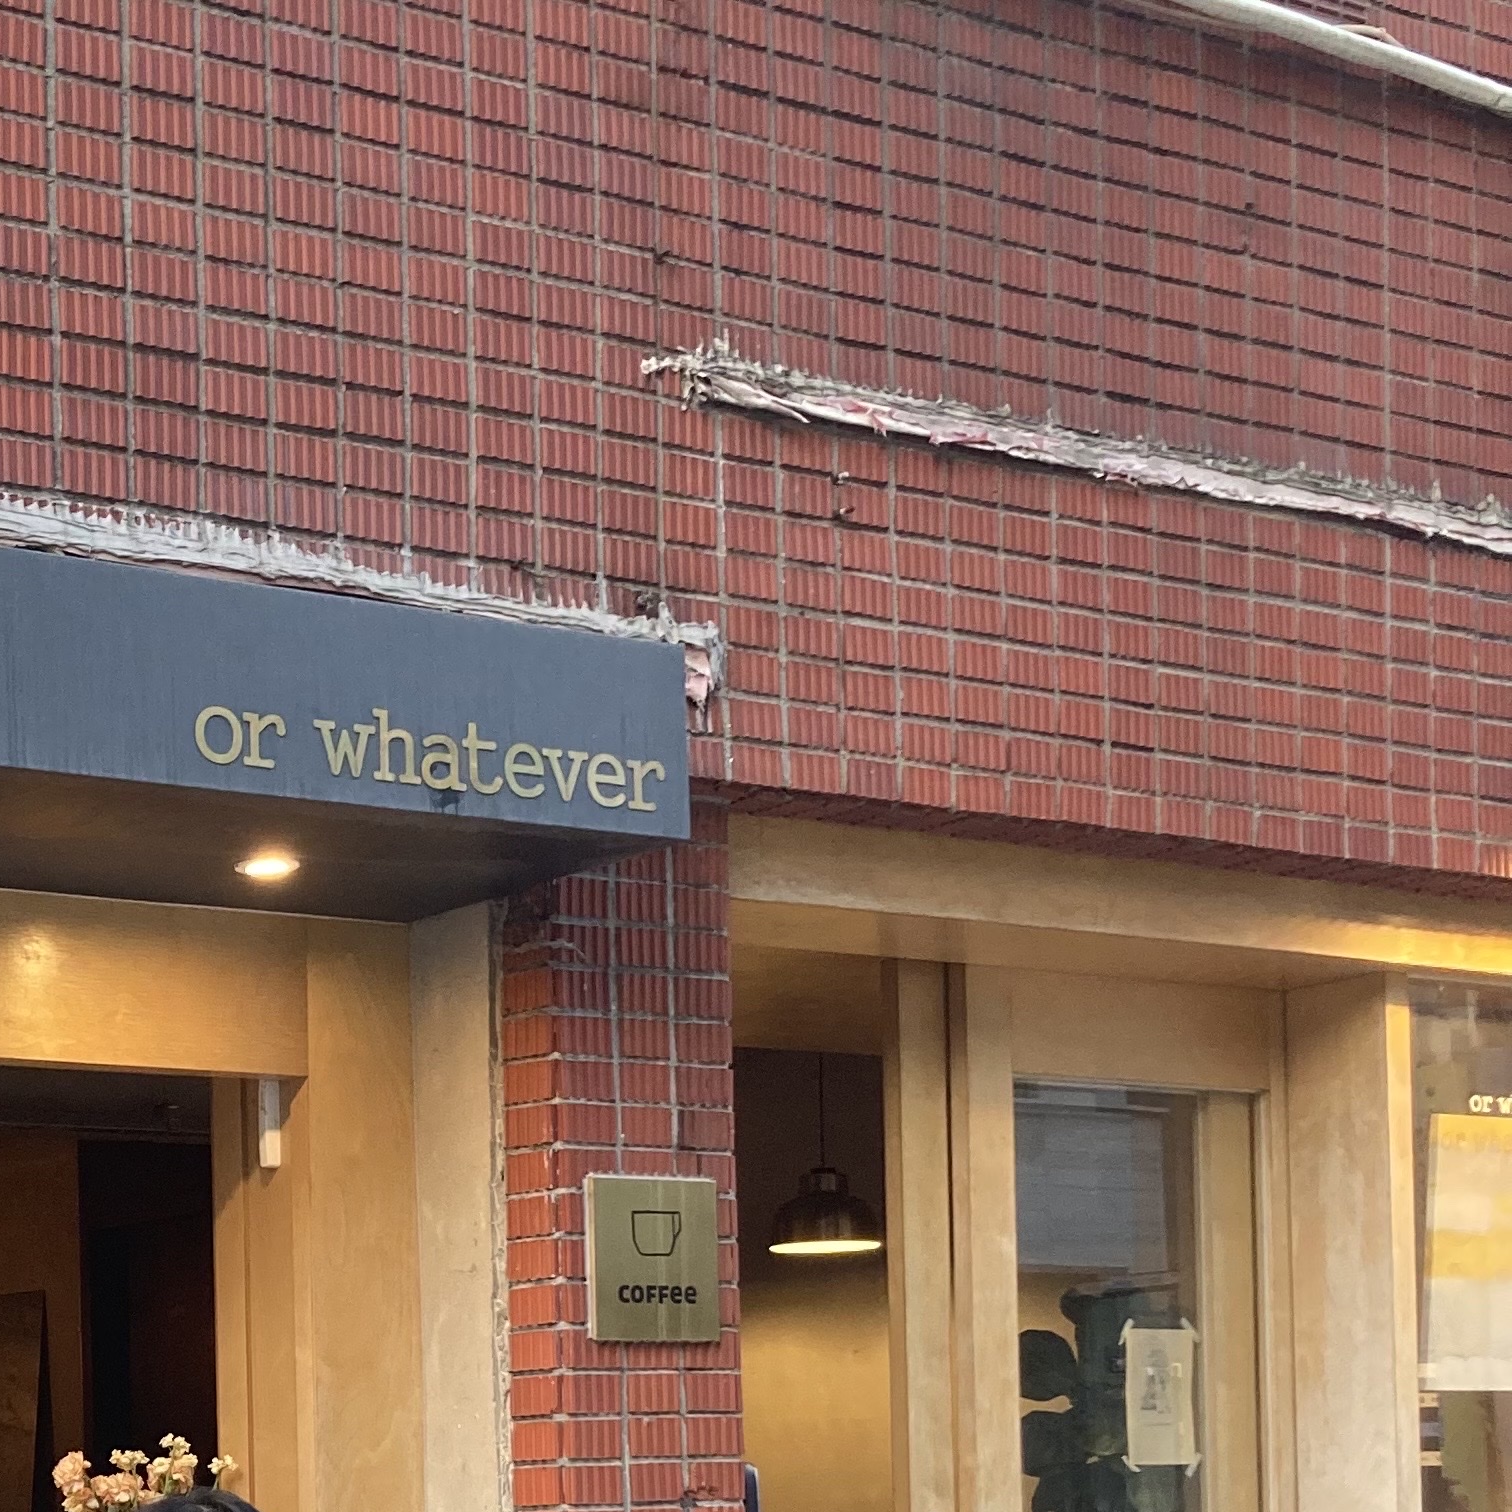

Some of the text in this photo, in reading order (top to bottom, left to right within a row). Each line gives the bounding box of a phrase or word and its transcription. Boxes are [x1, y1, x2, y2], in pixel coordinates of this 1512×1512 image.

[194, 705, 666, 812] or whatever
[1469, 1094, 1493, 1113] or
